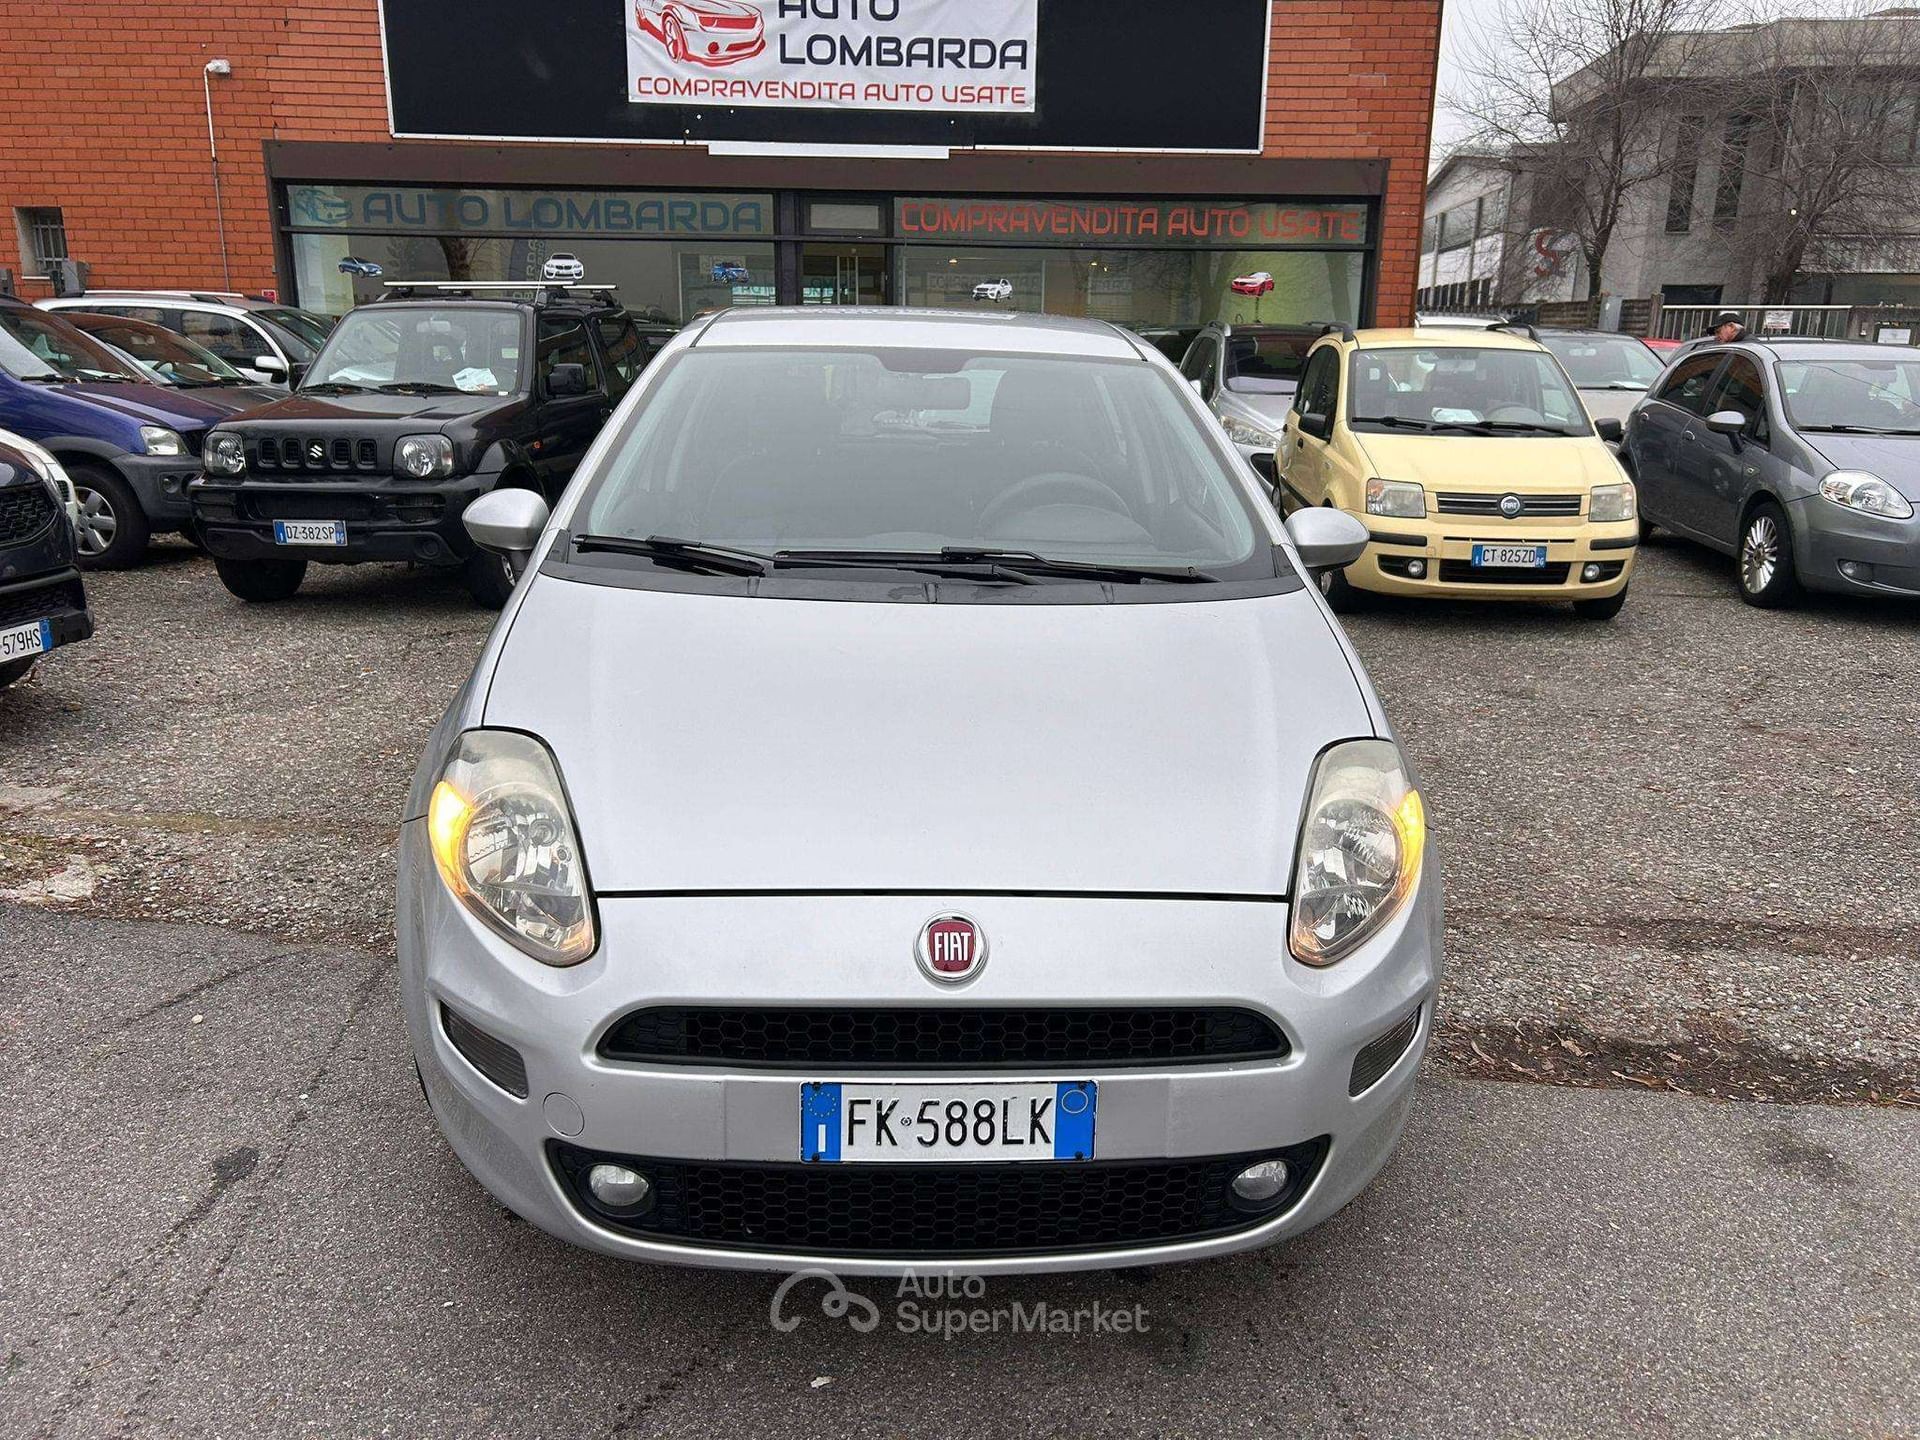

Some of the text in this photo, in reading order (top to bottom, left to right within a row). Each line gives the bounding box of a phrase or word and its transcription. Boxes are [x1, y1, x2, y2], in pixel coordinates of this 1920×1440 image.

[779, 0, 899, 21] AUTO
[780, 34, 1027, 70] LOMBARDA
[637, 76, 1026, 104] COMPRAVENDITA AUTO USATE
[364, 192, 762, 232] AUTO LOMBARDA
[901, 202, 1360, 240] COMPRAVENDITA AUTO USATE
[934, 931, 972, 962] FIAT
